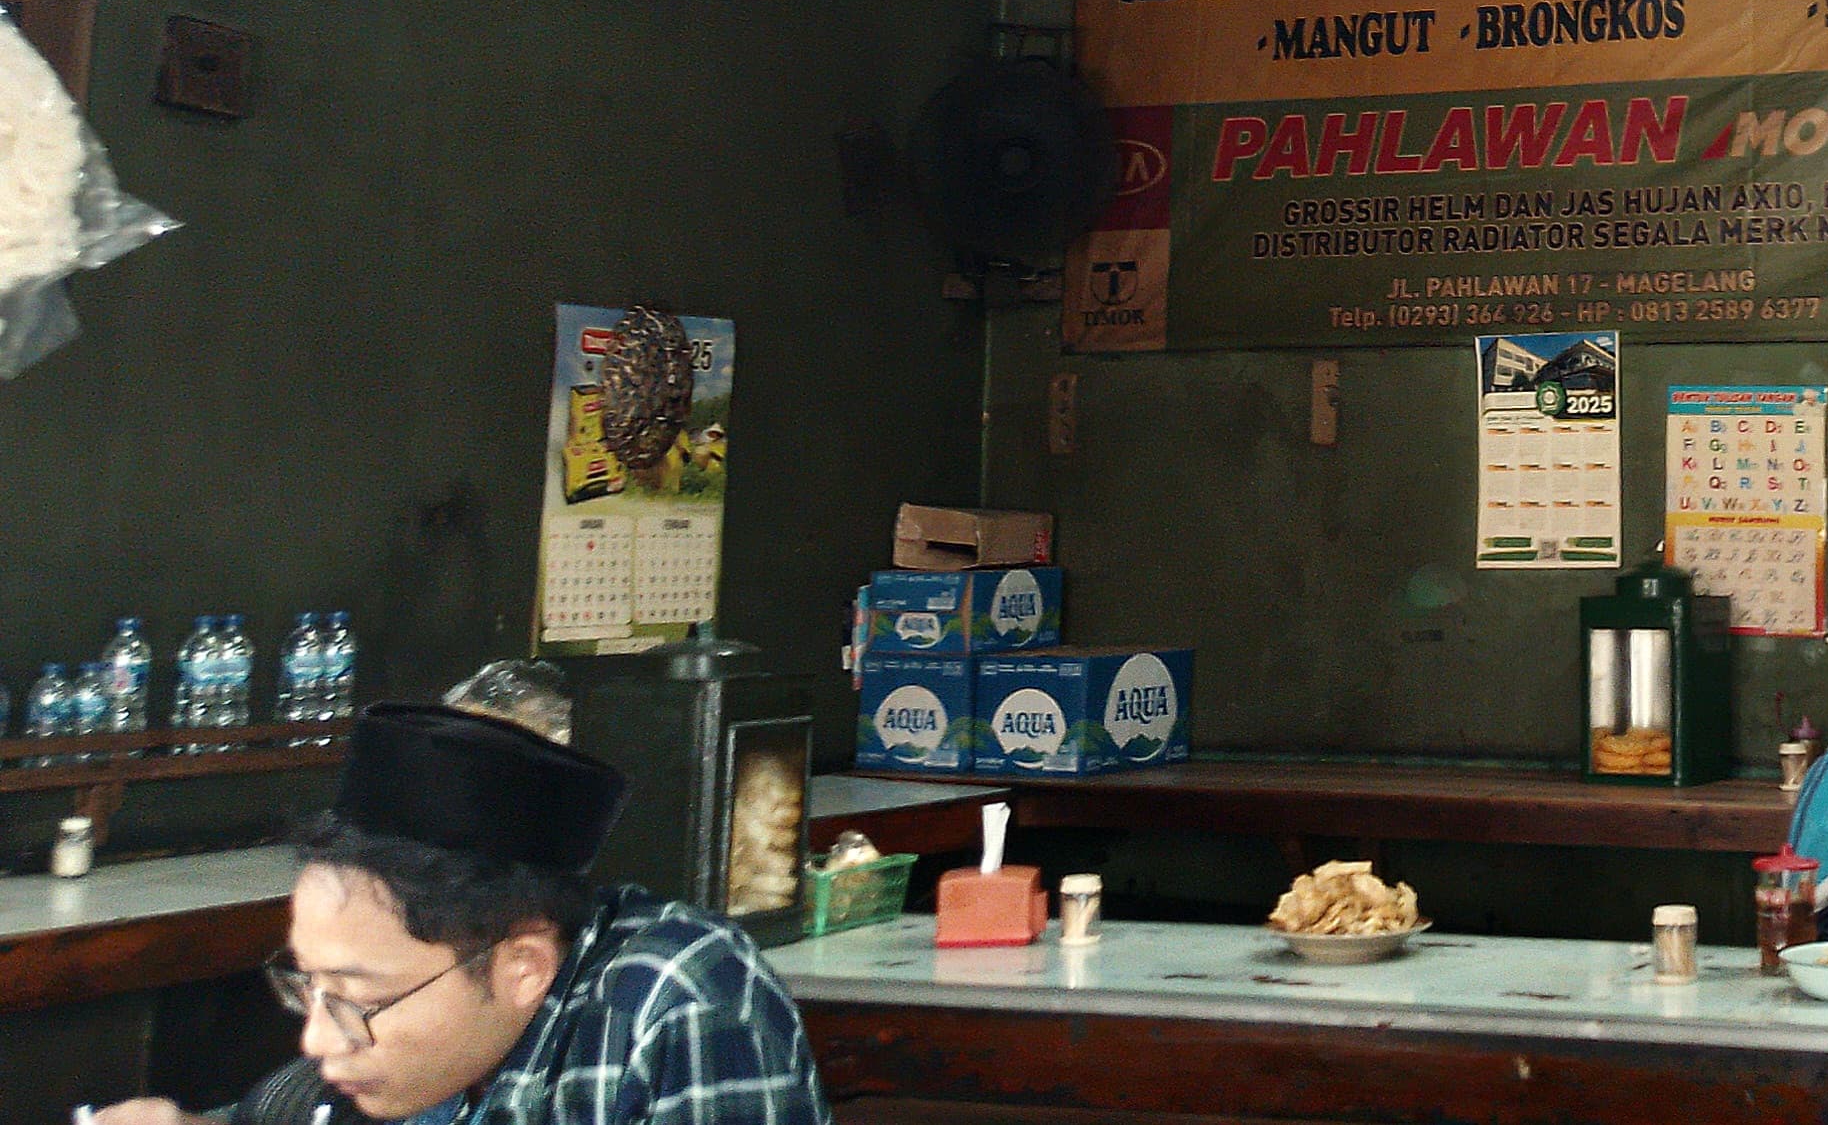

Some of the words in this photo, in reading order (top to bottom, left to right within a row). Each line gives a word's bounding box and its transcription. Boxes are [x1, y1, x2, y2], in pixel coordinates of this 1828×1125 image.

[1272, 10, 1435, 60] MANGUT
[1212, 95, 1689, 182] PAHLAWAN
[1284, 196, 1401, 227] GROSSIR
[1408, 193, 1485, 222] HELM
[1495, 190, 1555, 218] DAN
[1560, 188, 1614, 217] JAS
[1622, 185, 1723, 215] HUJAN
[1732, 182, 1813, 215] AXIO,
[1253, 227, 1435, 260] DISTRIBUTOR
[1441, 222, 1584, 254] RADIATOR
[1593, 218, 1710, 250] SEGALA
[1720, 215, 1809, 244] MERK
[1387, 277, 1419, 301] JL.
[1426, 274, 1559, 298] PAHLAWAN
[1568, 274, 1590, 296] 17
[1617, 269, 1756, 293] MAGELANG
[1329, 306, 1384, 331] Telp.
[1388, 302, 1459, 329] (0293)
[1512, 301, 1553, 324] 926
[1577, 300, 1611, 322] HP
[1630, 299, 1688, 322] 0813
[1695, 298, 1752, 321] 2589
[1761, 296, 1820, 320] 6377
[1566, 395, 1613, 414] 2025
[884, 709, 936, 734] AQUA
[1115, 686, 1168, 725] AQUA
[1002, 712, 1055, 738] AQUA
